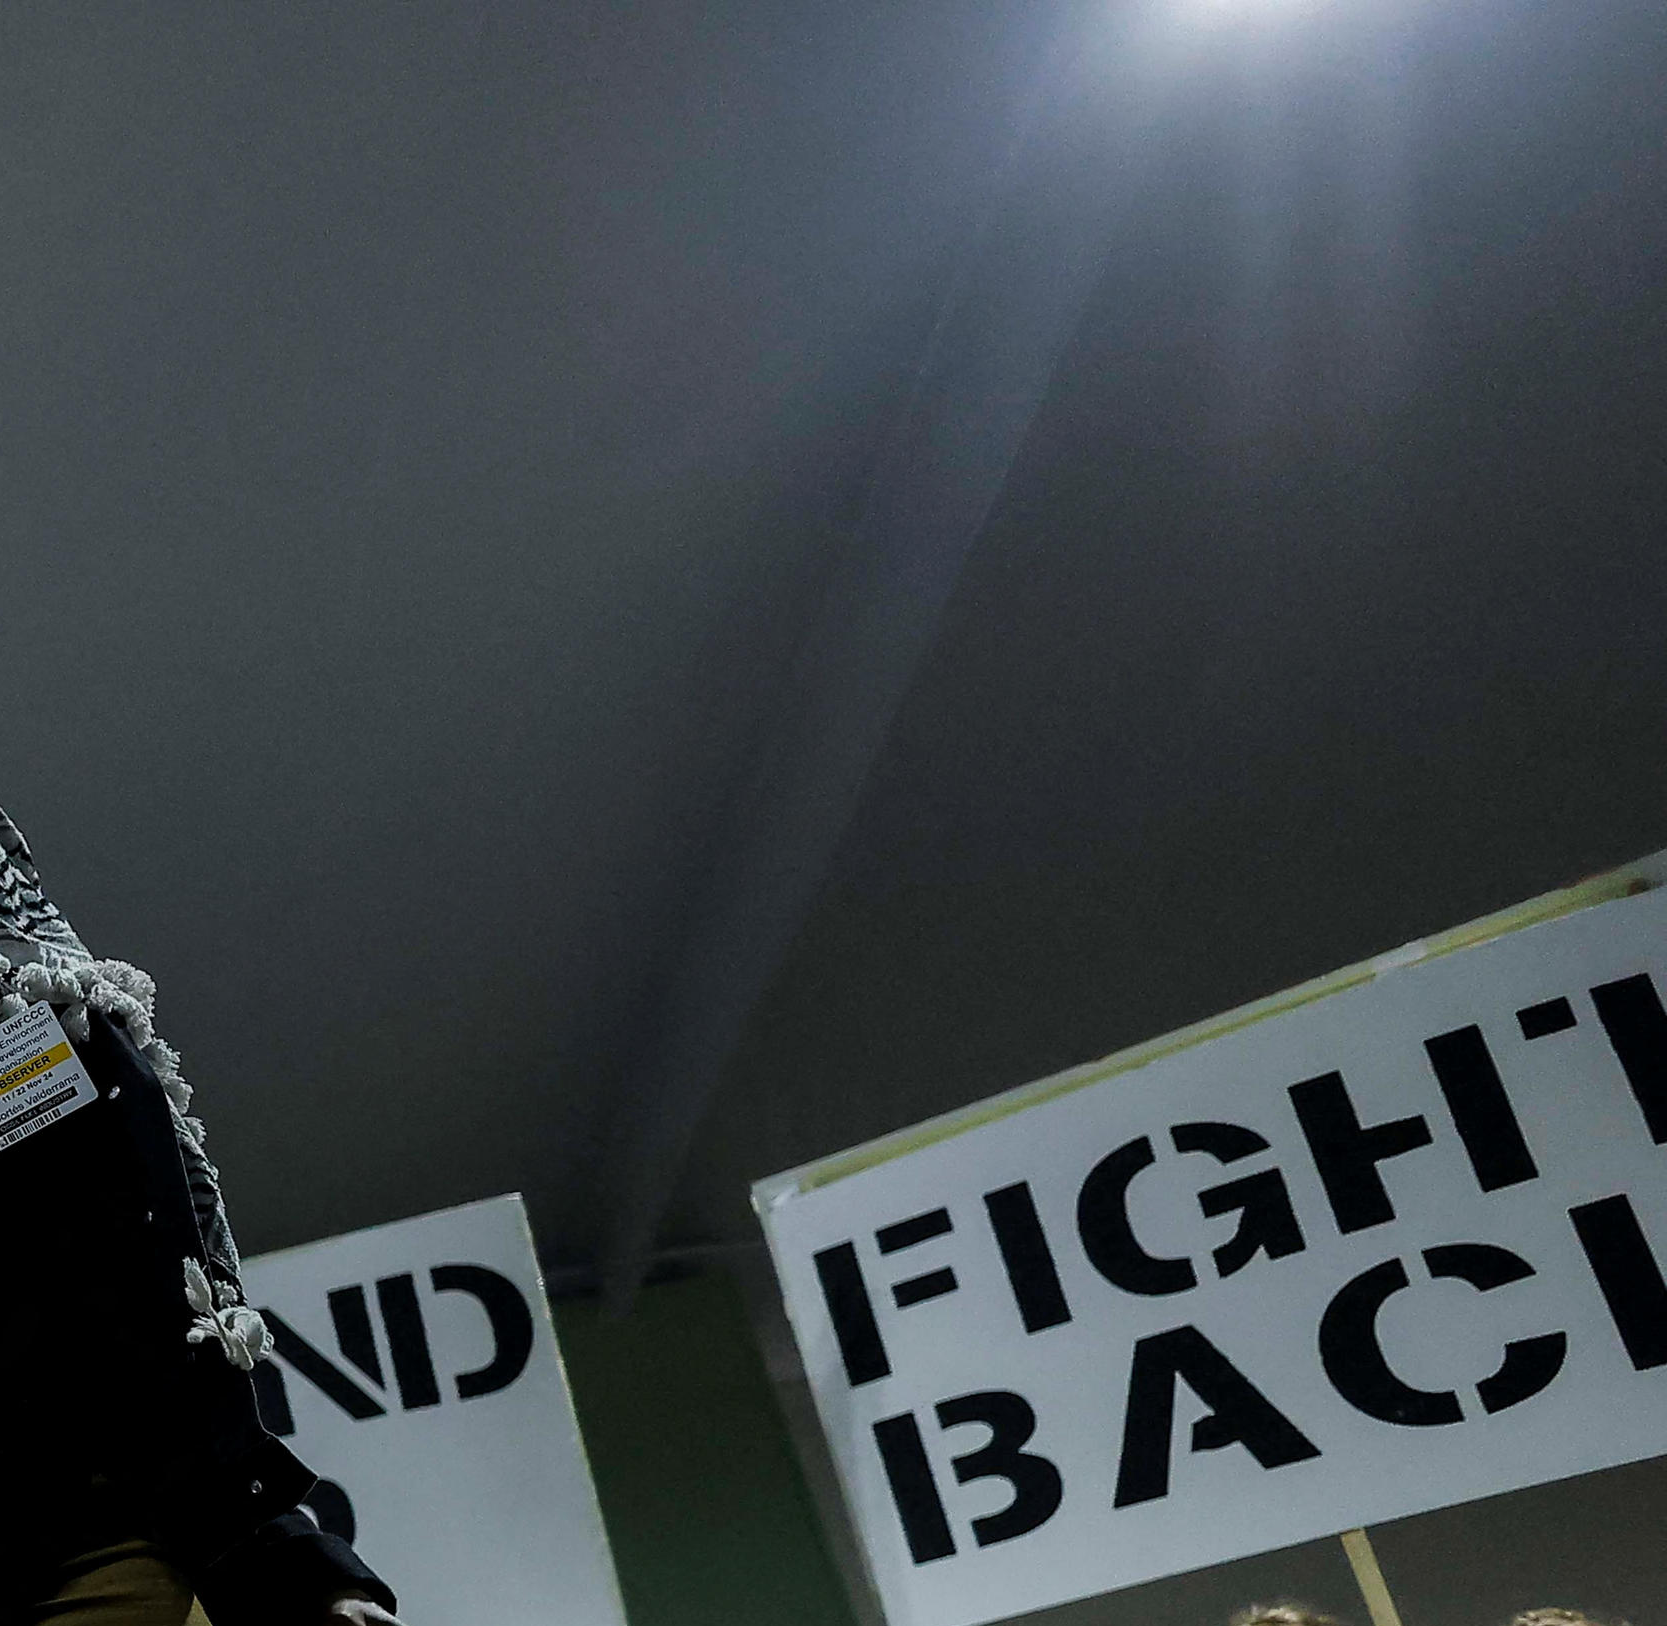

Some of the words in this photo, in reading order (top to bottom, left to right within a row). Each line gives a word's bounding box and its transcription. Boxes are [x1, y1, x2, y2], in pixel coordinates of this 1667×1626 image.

[0, 1015, 54, 1049] Environment
[2, 1006, 46, 1036] UNFCCC
[1, 1094, 11, 1104] 11
[16, 1084, 27, 1096] 22
[26, 1076, 42, 1092] Nov
[26, 1073, 80, 1106] Valderrama
